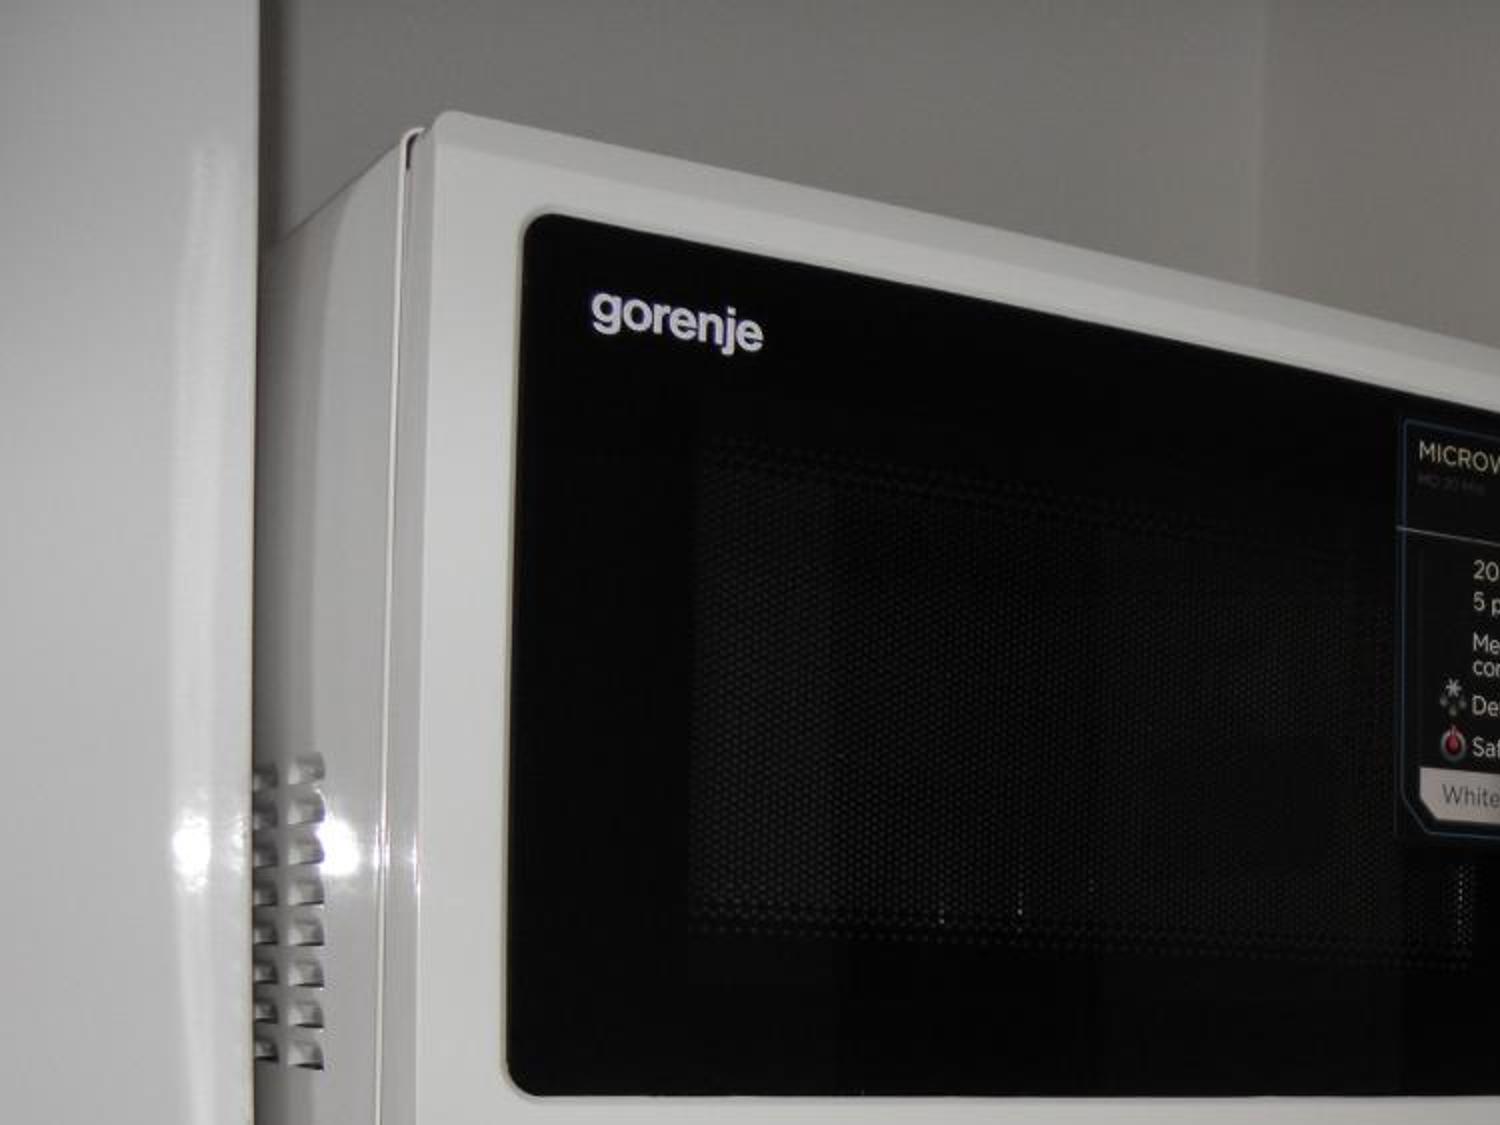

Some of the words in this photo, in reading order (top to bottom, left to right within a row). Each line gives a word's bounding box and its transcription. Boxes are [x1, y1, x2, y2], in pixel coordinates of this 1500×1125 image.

[591, 293, 764, 356] gorenje
[1473, 559, 1499, 582] 20
[1473, 591, 1486, 612] 5
[1442, 783, 1500, 809] White
